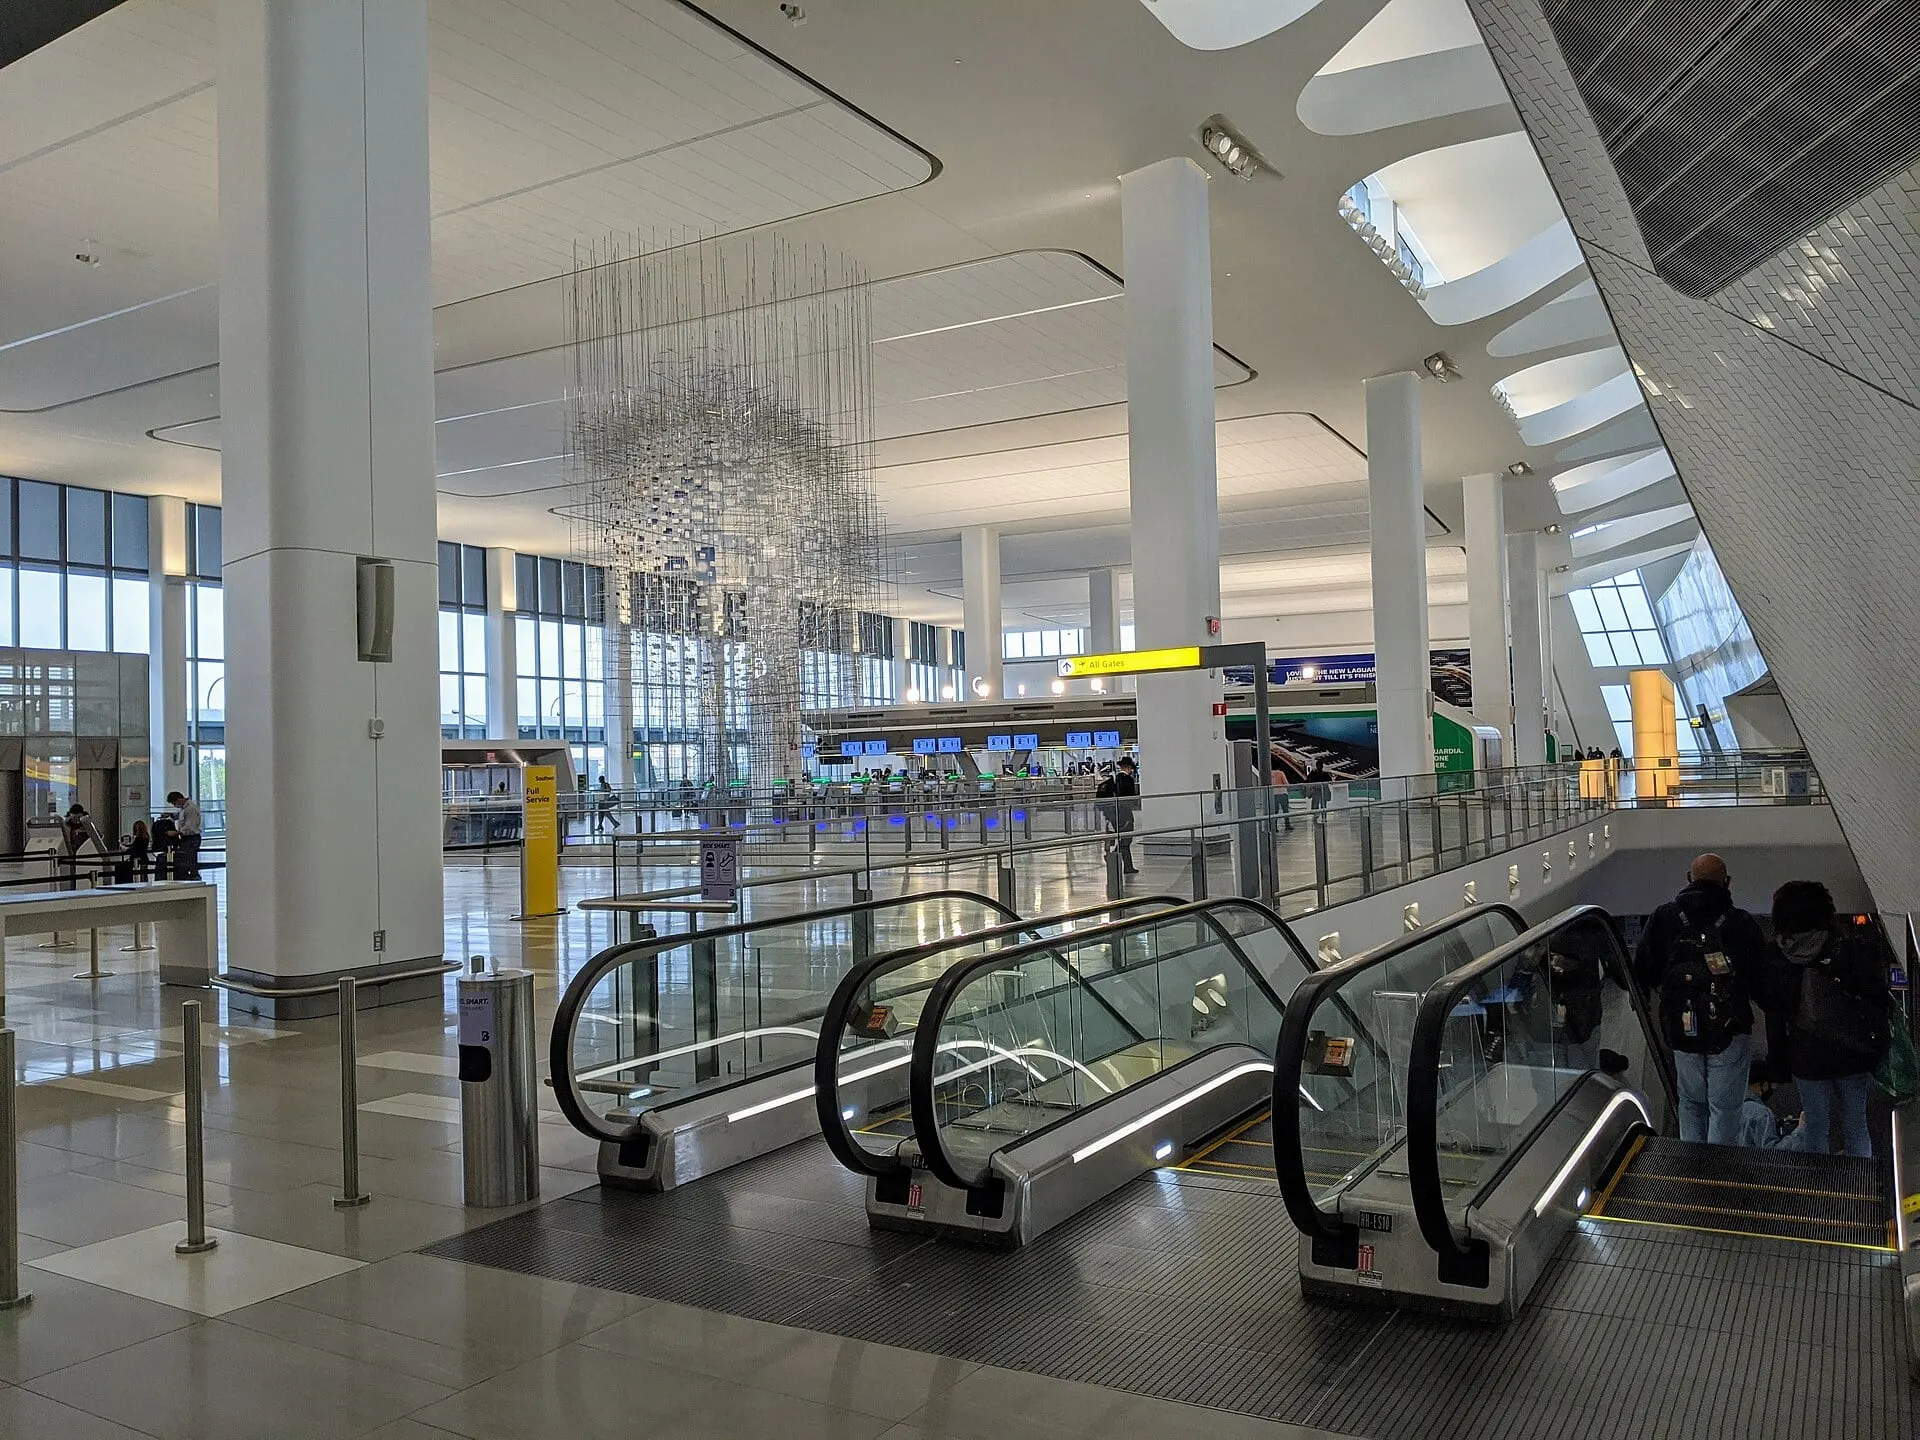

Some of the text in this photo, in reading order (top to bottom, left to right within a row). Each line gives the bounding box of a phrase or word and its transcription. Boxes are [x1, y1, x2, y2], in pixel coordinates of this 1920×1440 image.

[1090, 660, 1125, 669] All Gates
[526, 787, 540, 795] Full
[526, 796, 550, 804] Service
